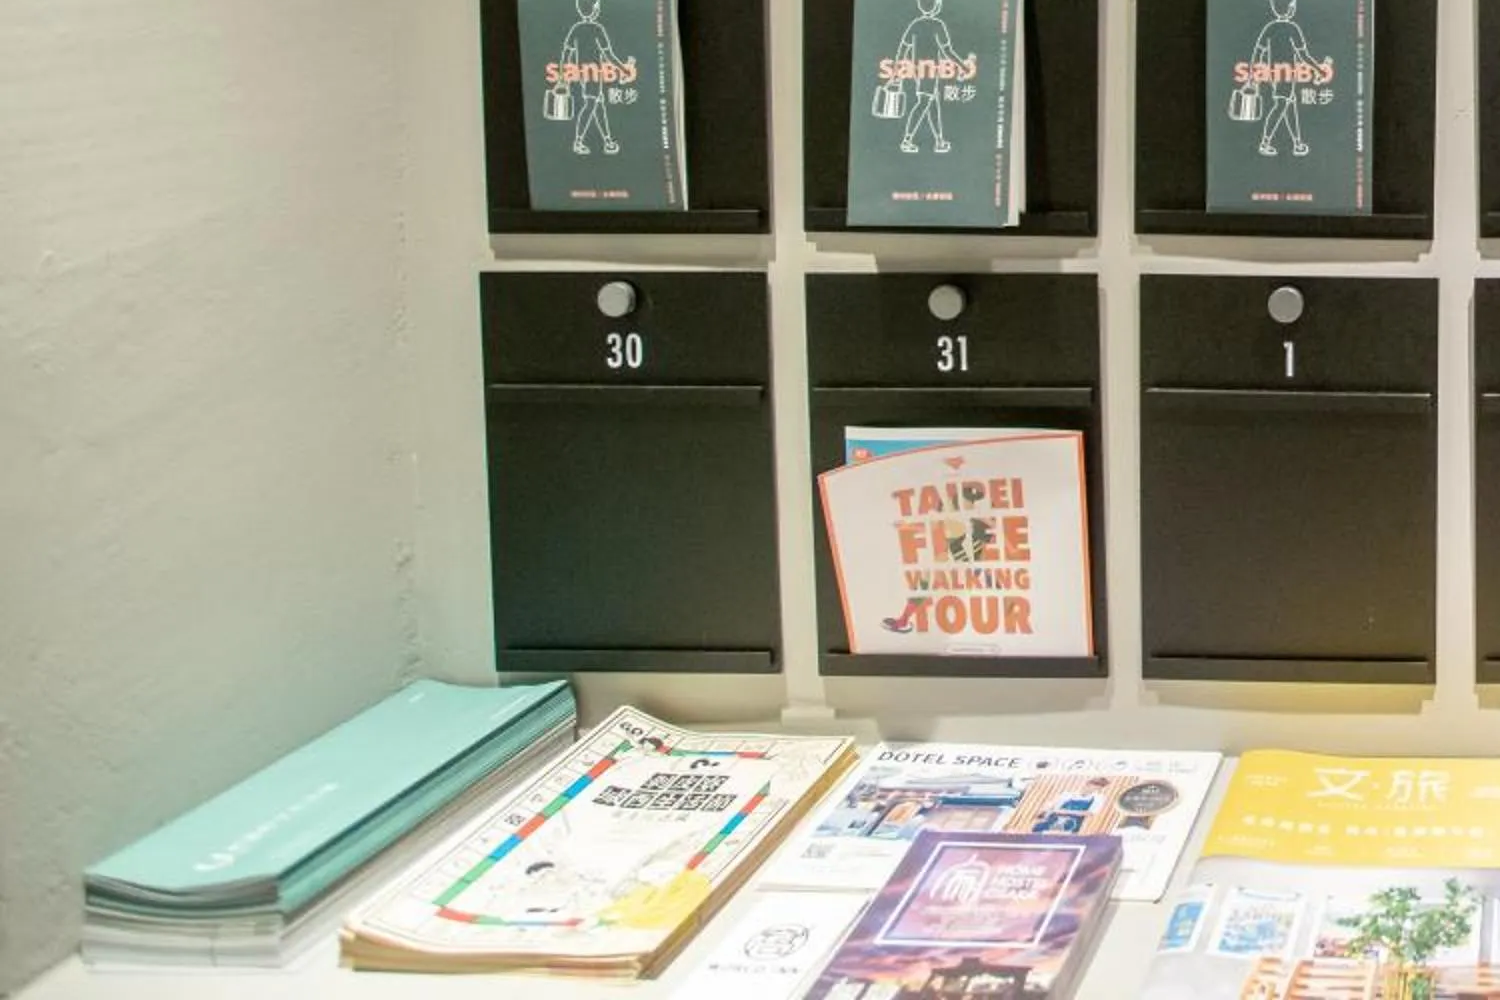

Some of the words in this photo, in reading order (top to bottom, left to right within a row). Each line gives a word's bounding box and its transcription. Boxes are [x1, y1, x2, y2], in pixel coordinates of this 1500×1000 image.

[606, 332, 643, 369] 30
[936, 335, 968, 372] 31
[1283, 341, 1294, 378] 1
[892, 478, 1025, 517] TAIPEI
[893, 515, 1031, 565] FREE
[905, 567, 1031, 591] WALKING
[905, 594, 1034, 635] TOUR
